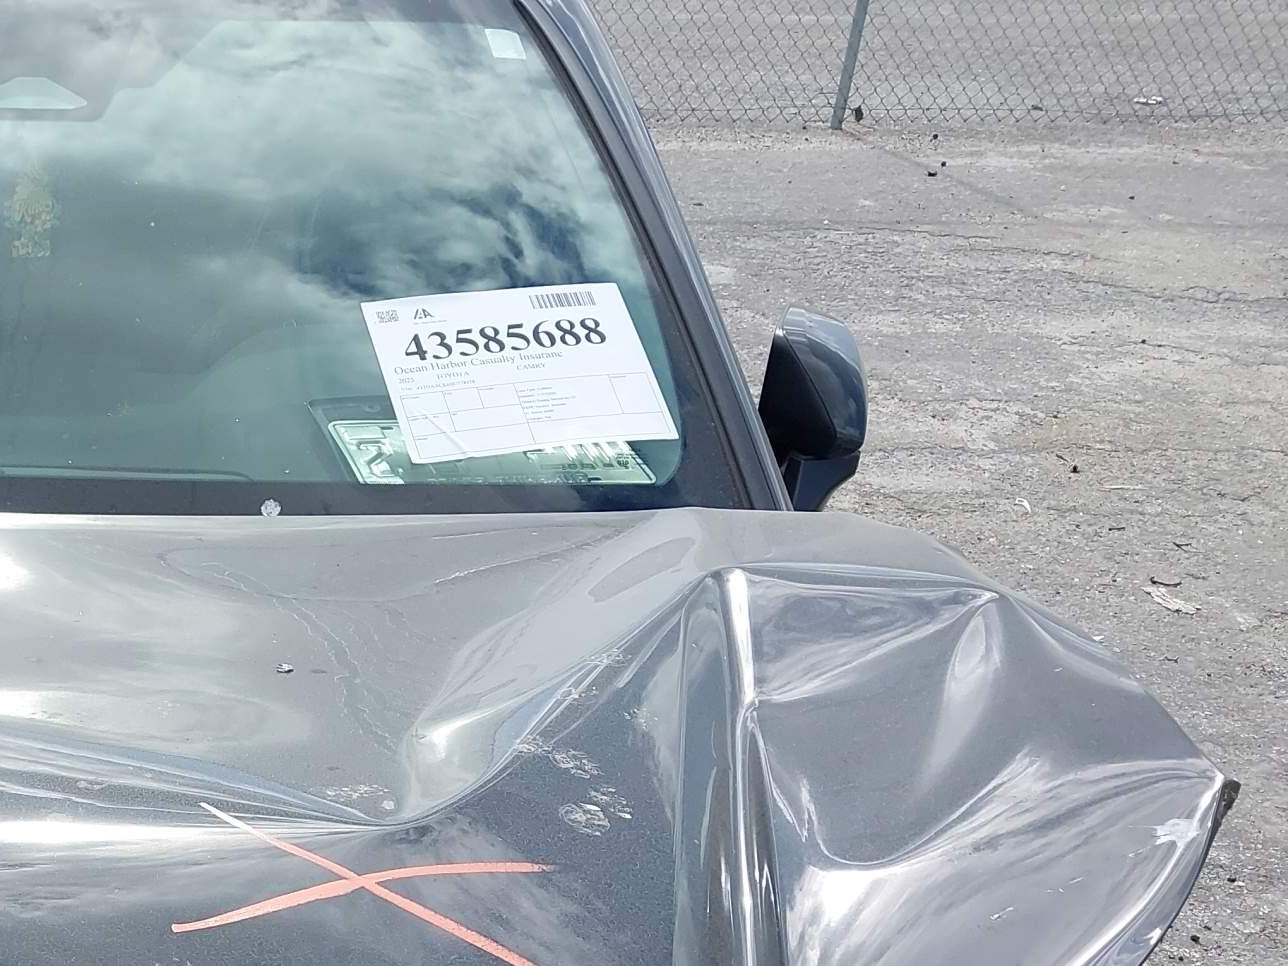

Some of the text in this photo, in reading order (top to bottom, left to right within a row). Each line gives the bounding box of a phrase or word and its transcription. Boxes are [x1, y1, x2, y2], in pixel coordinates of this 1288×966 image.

[404, 317, 607, 361] 43585688
[394, 365, 428, 375] Ocean
[431, 360, 467, 371] Harbor
[470, 355, 516, 366] Casualty
